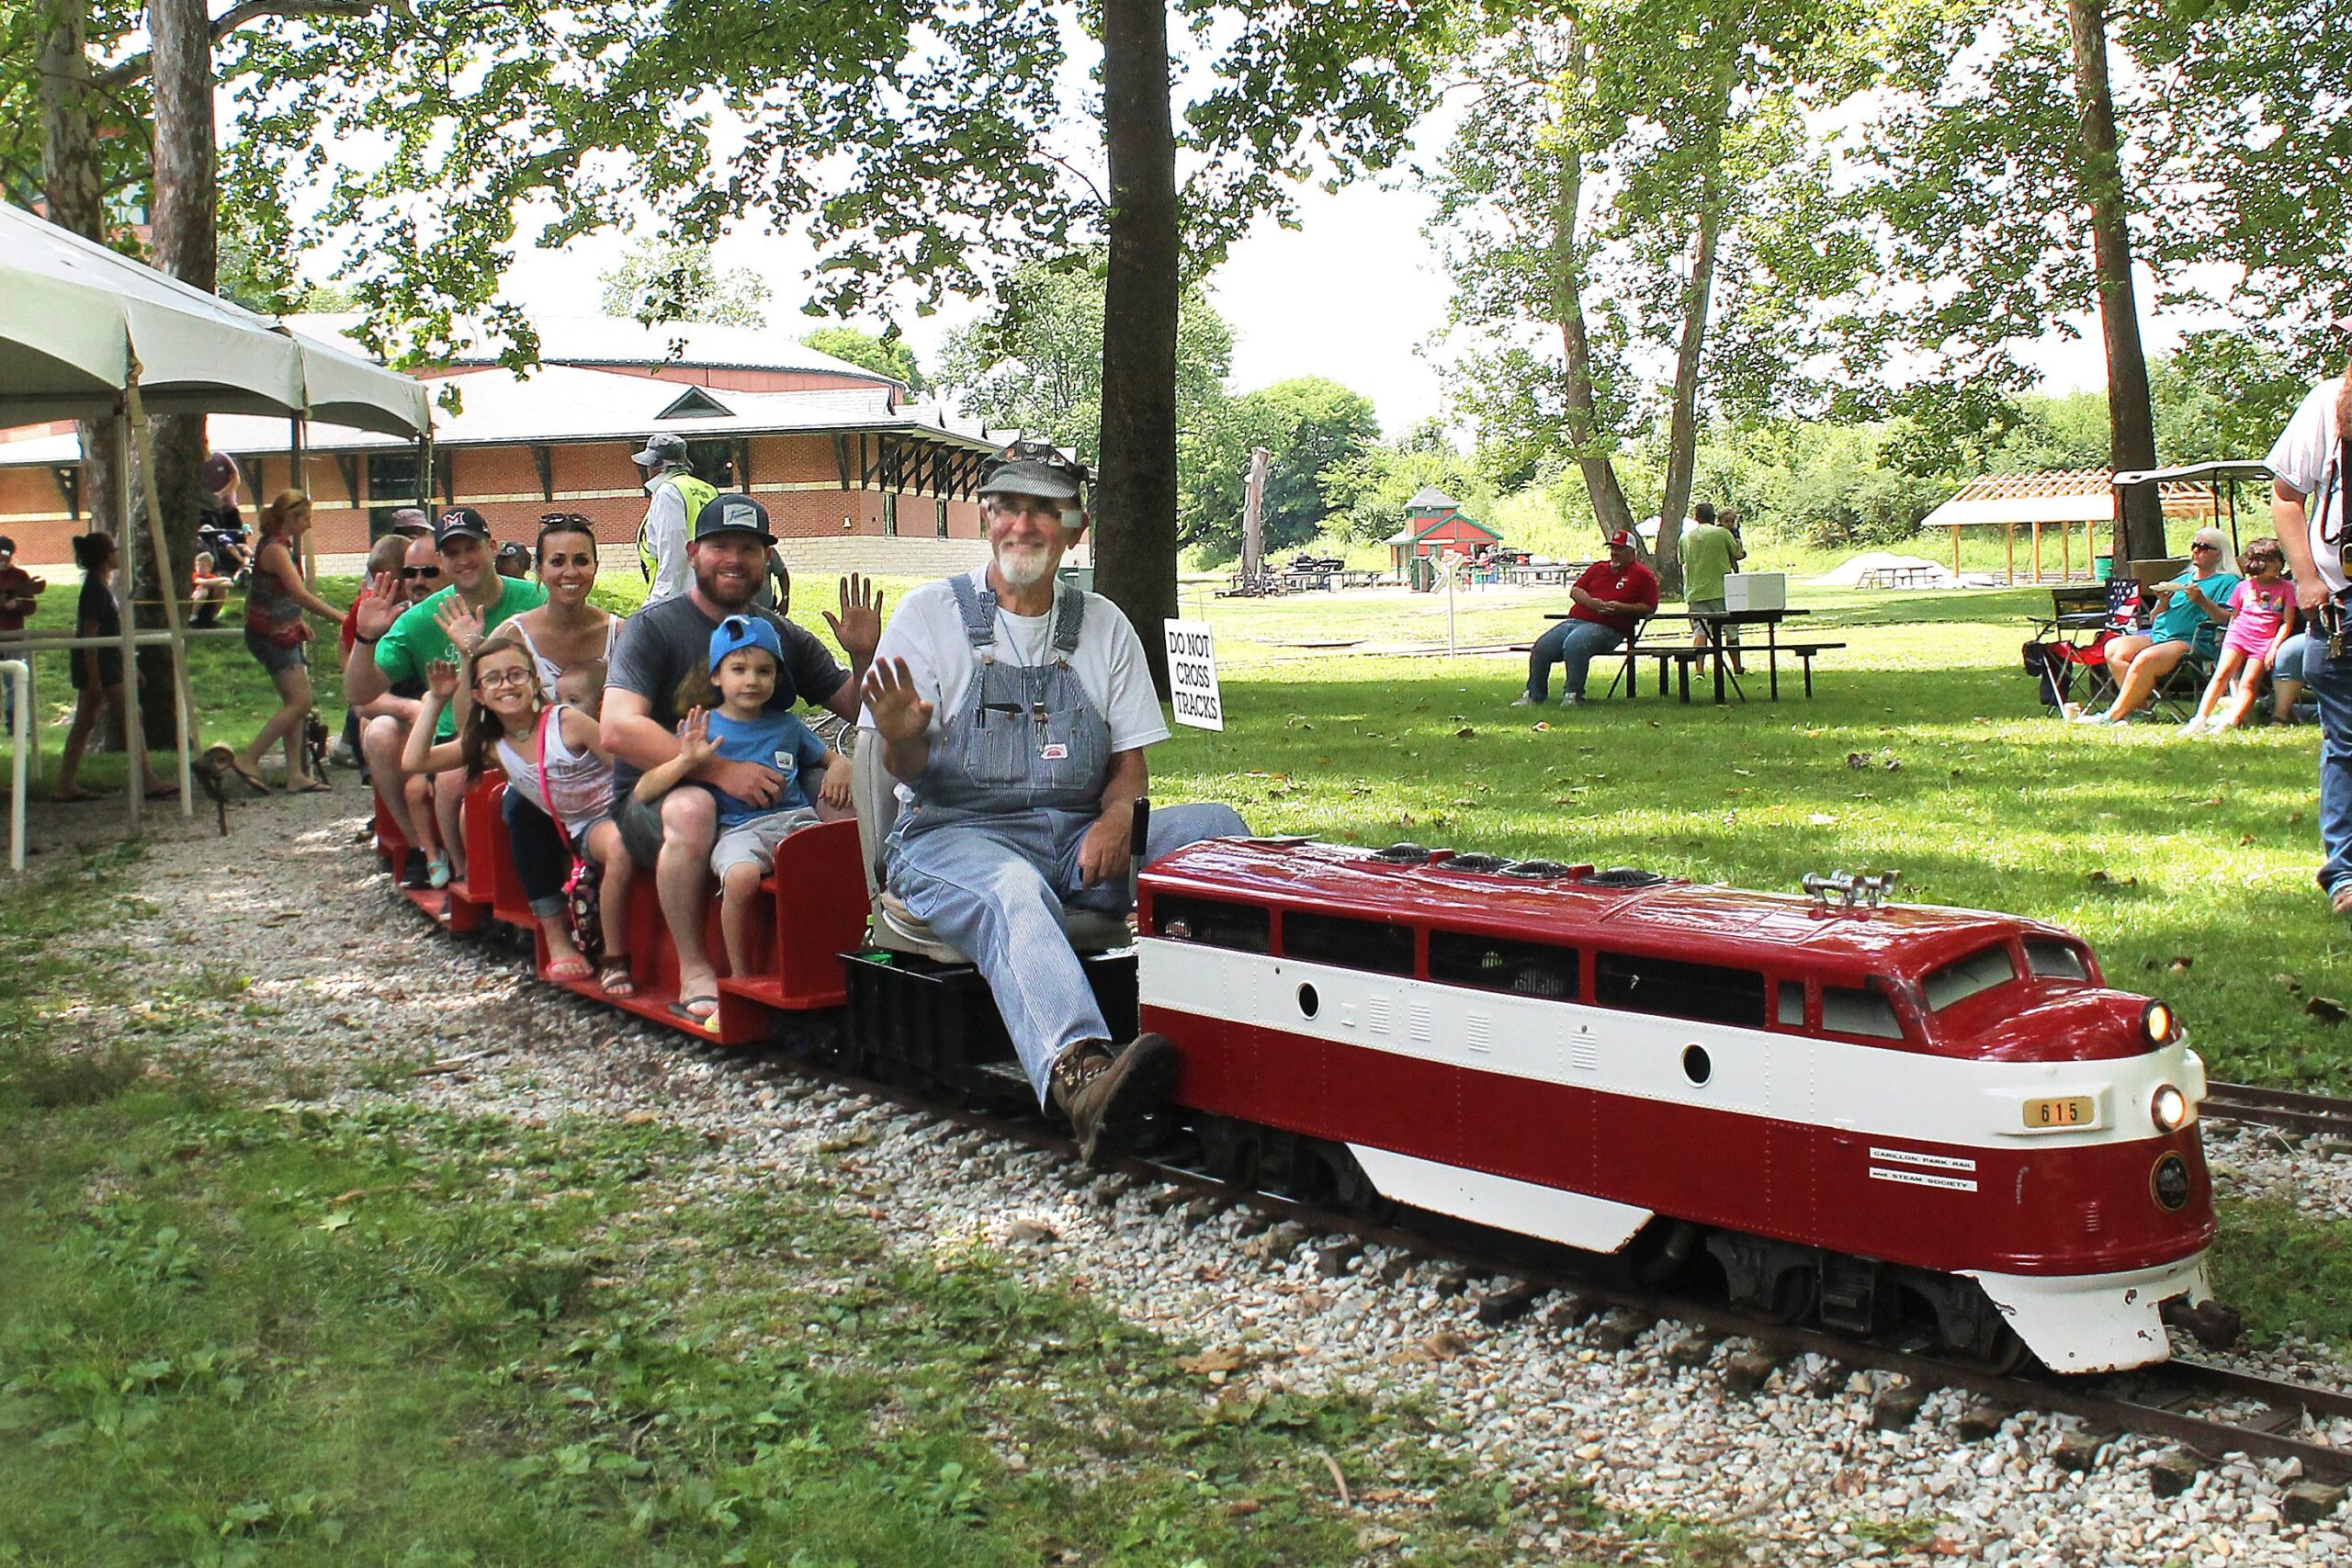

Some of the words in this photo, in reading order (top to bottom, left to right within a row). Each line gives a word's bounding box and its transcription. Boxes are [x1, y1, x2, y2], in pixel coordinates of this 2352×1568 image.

[442, 512, 466, 530] M
[1169, 631, 1185, 655] DO
[1186, 632, 1209, 658] NOT
[1176, 661, 1210, 689] CROSS
[1175, 691, 1217, 719] TRACKS
[2041, 1103, 2077, 1122] 615
[1873, 1151, 1918, 1162] CARILLON
[1922, 1156, 1947, 1166] PARK
[1892, 1173, 1923, 1182] STEAM
[1927, 1179, 1968, 1188] SOCIETY
